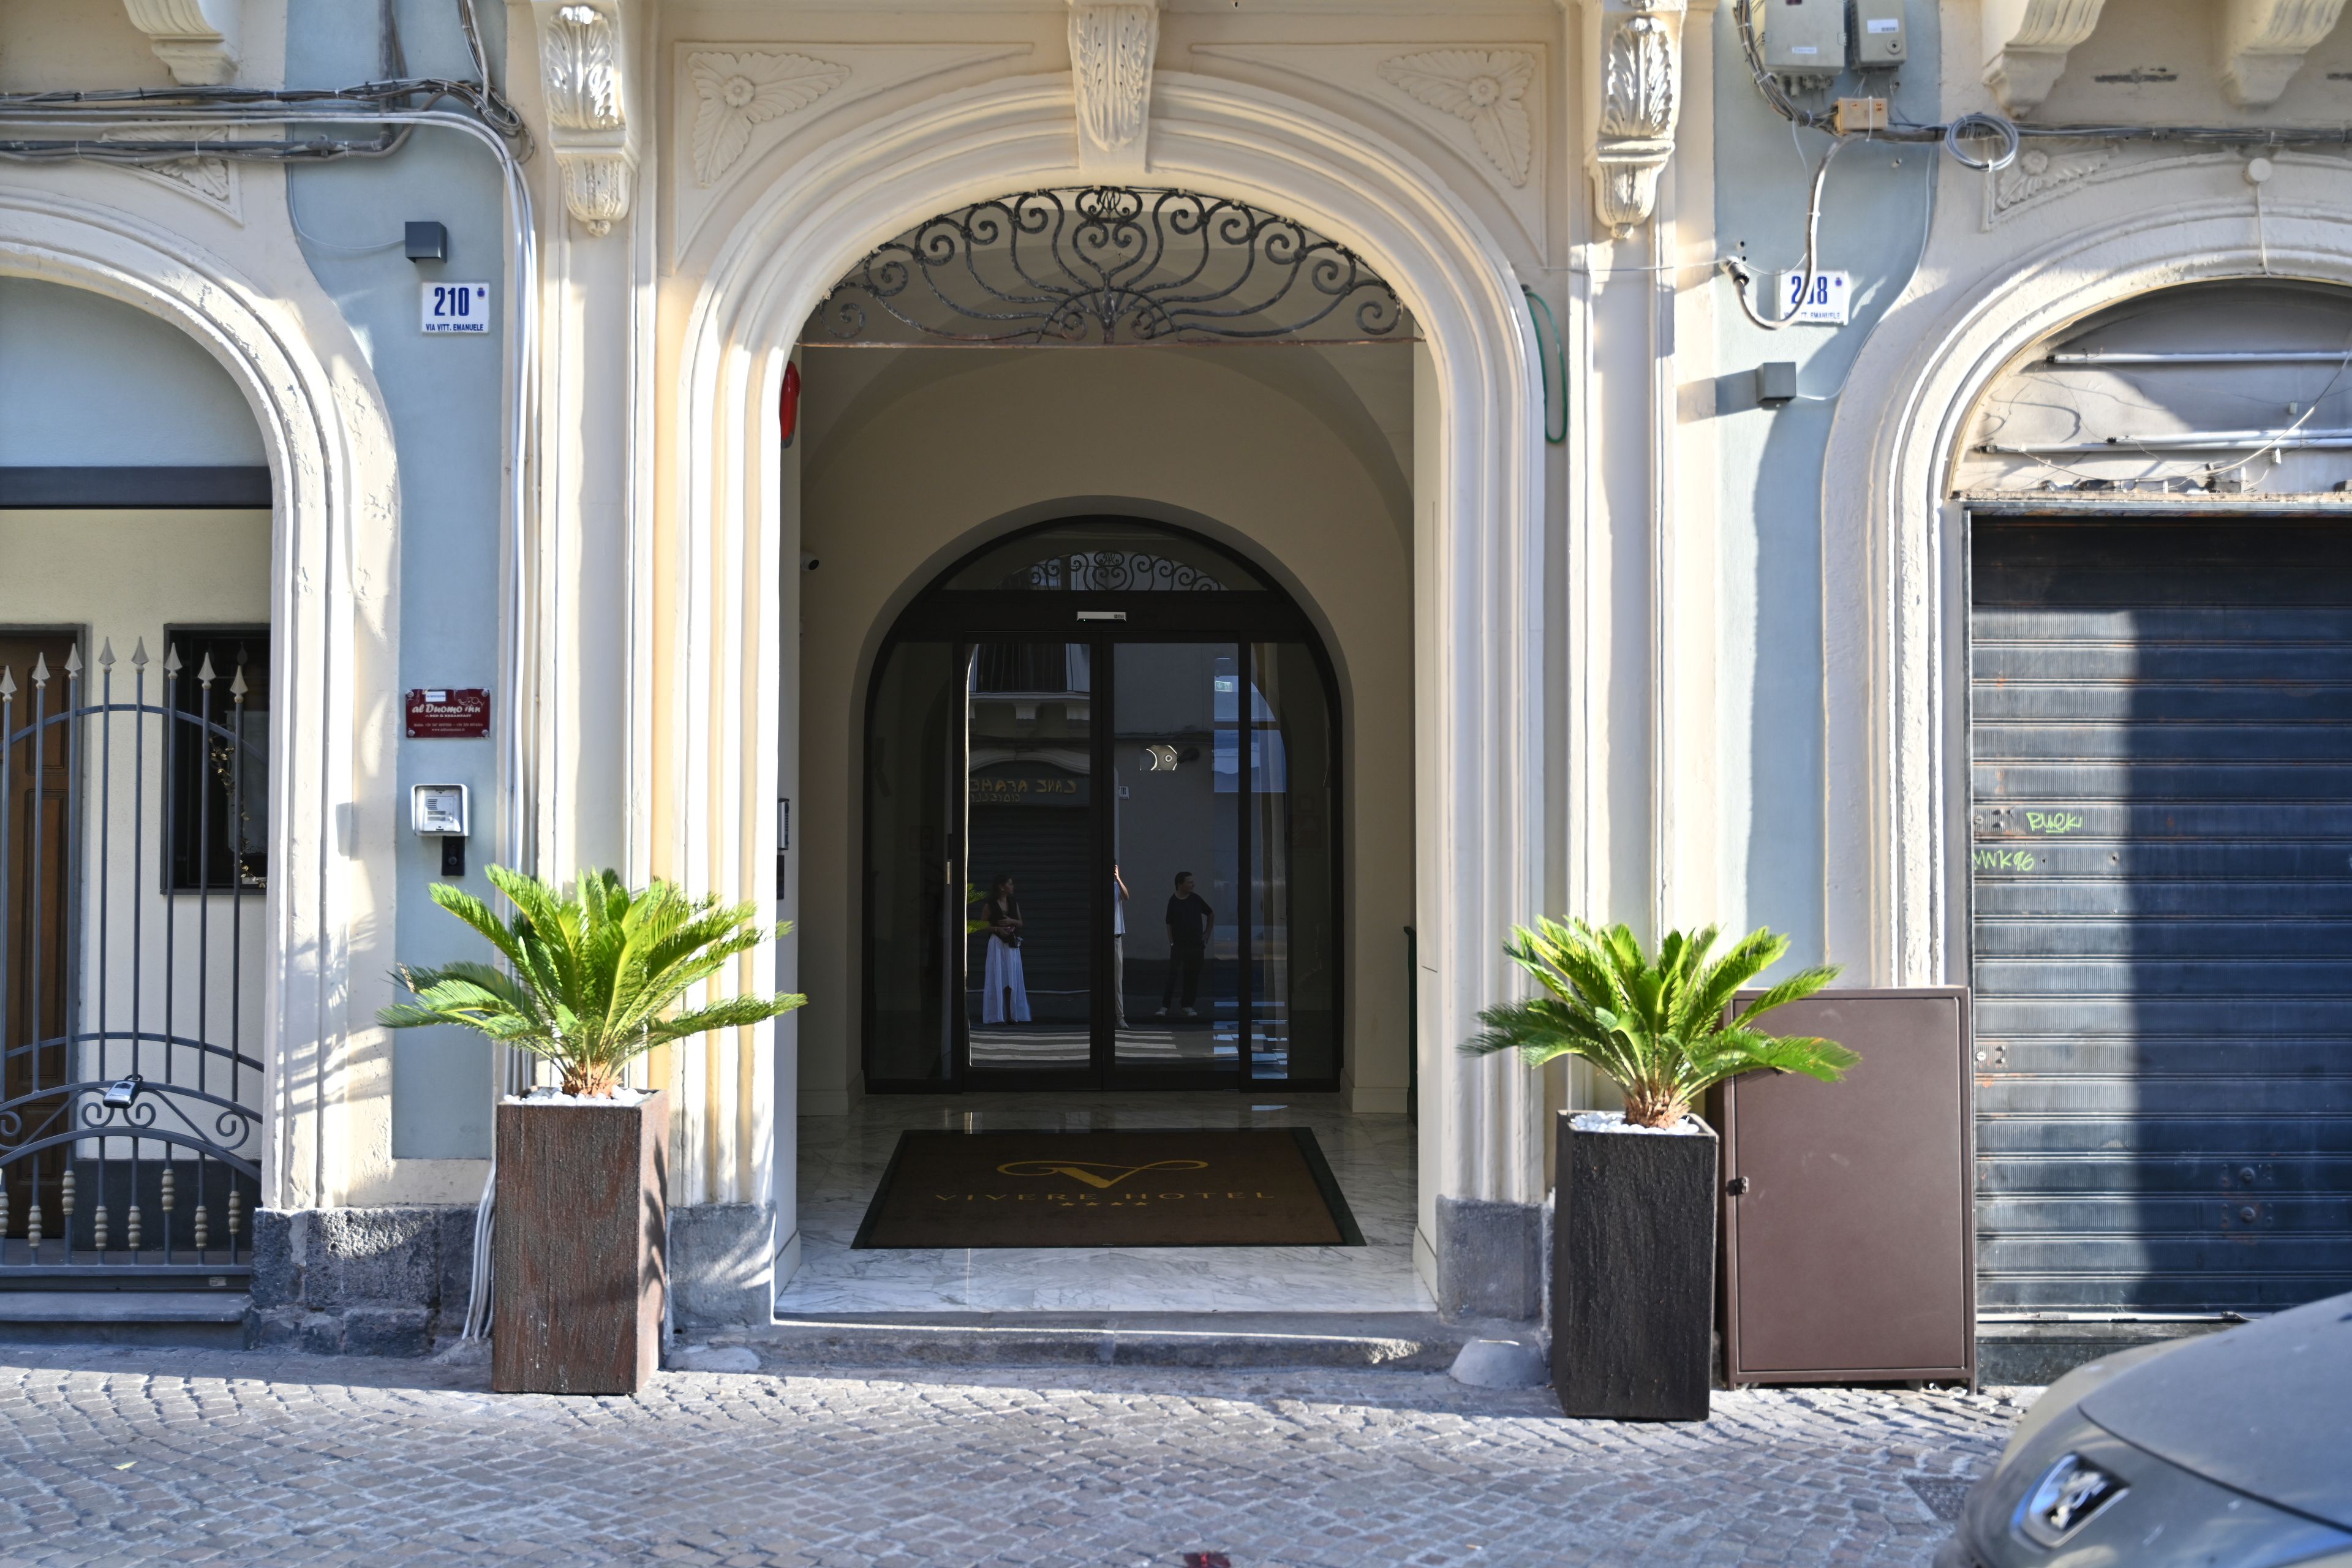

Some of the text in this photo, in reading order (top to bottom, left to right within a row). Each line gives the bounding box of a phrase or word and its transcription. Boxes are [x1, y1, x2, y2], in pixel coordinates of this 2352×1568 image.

[434, 287, 470, 317] 210
[412, 704, 424, 713] al
[425, 703, 462, 714] Duomo
